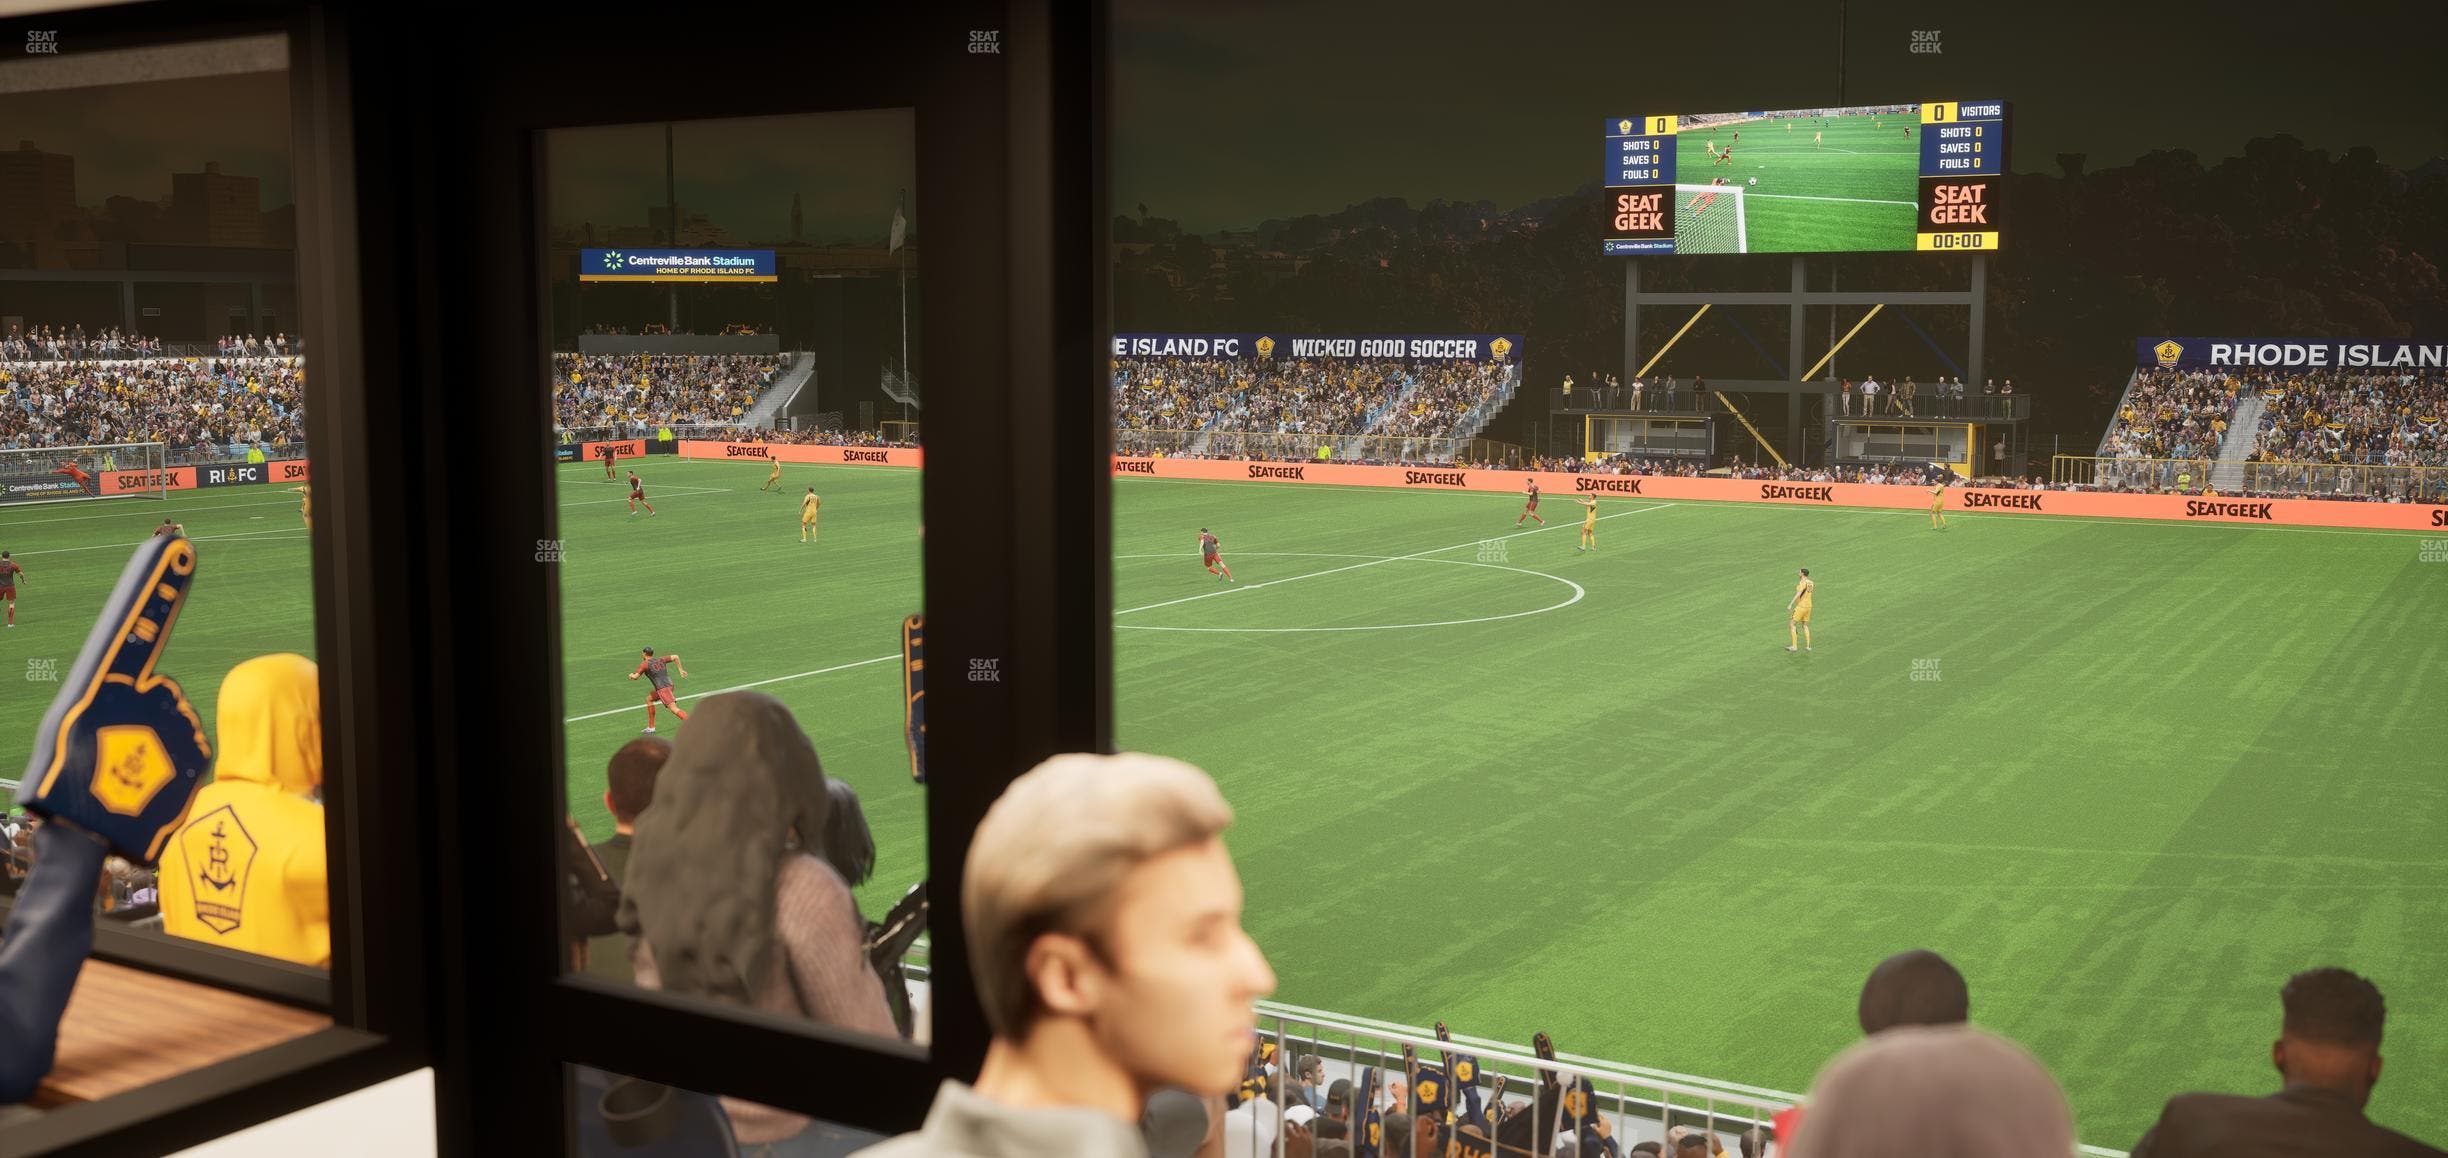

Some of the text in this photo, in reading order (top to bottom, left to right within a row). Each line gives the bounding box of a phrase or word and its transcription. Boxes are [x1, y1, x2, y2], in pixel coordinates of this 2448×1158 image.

[1934, 105, 2000, 121] 0 VISITORS
[1657, 118, 1666, 133] 0
[1940, 126, 1982, 138] SHOTS 0
[1623, 140, 1660, 151] SHOTS 0
[1940, 142, 1982, 154] SAVES 0
[1623, 154, 1659, 165] SAVES 0
[1940, 158, 1980, 168] FOULS 0
[1623, 169, 1658, 180] FOULS 0
[1934, 184, 1986, 204] SEAT
[1618, 194, 1662, 212] SEAT
[1614, 212, 1664, 230] GEEK
[1930, 204, 1987, 224] GEEK
[1933, 234, 1982, 248] 00:00
[712, 256, 754, 266] Stadium
[1132, 338, 1208, 356] ISLAND
[1213, 339, 1238, 356] FC
[1292, 338, 1476, 358] WICKED GOOD SOCCER
[2210, 344, 2448, 367] RHODE ISLAN
[726, 445, 768, 458] SEATGEEK
[844, 450, 888, 463] SEATGEEK
[1116, 461, 1155, 474] ATGEEK
[1248, 465, 1304, 480] SEATGEEK
[210, 468, 256, 484] RI FC
[1406, 470, 1466, 487] SEATGEEK
[1576, 477, 1642, 494] SEATGEEK
[1761, 484, 1832, 502] SEATGEEK
[1964, 491, 2042, 510] SEATGEEK
[2186, 500, 2272, 520] SEATGEEK
